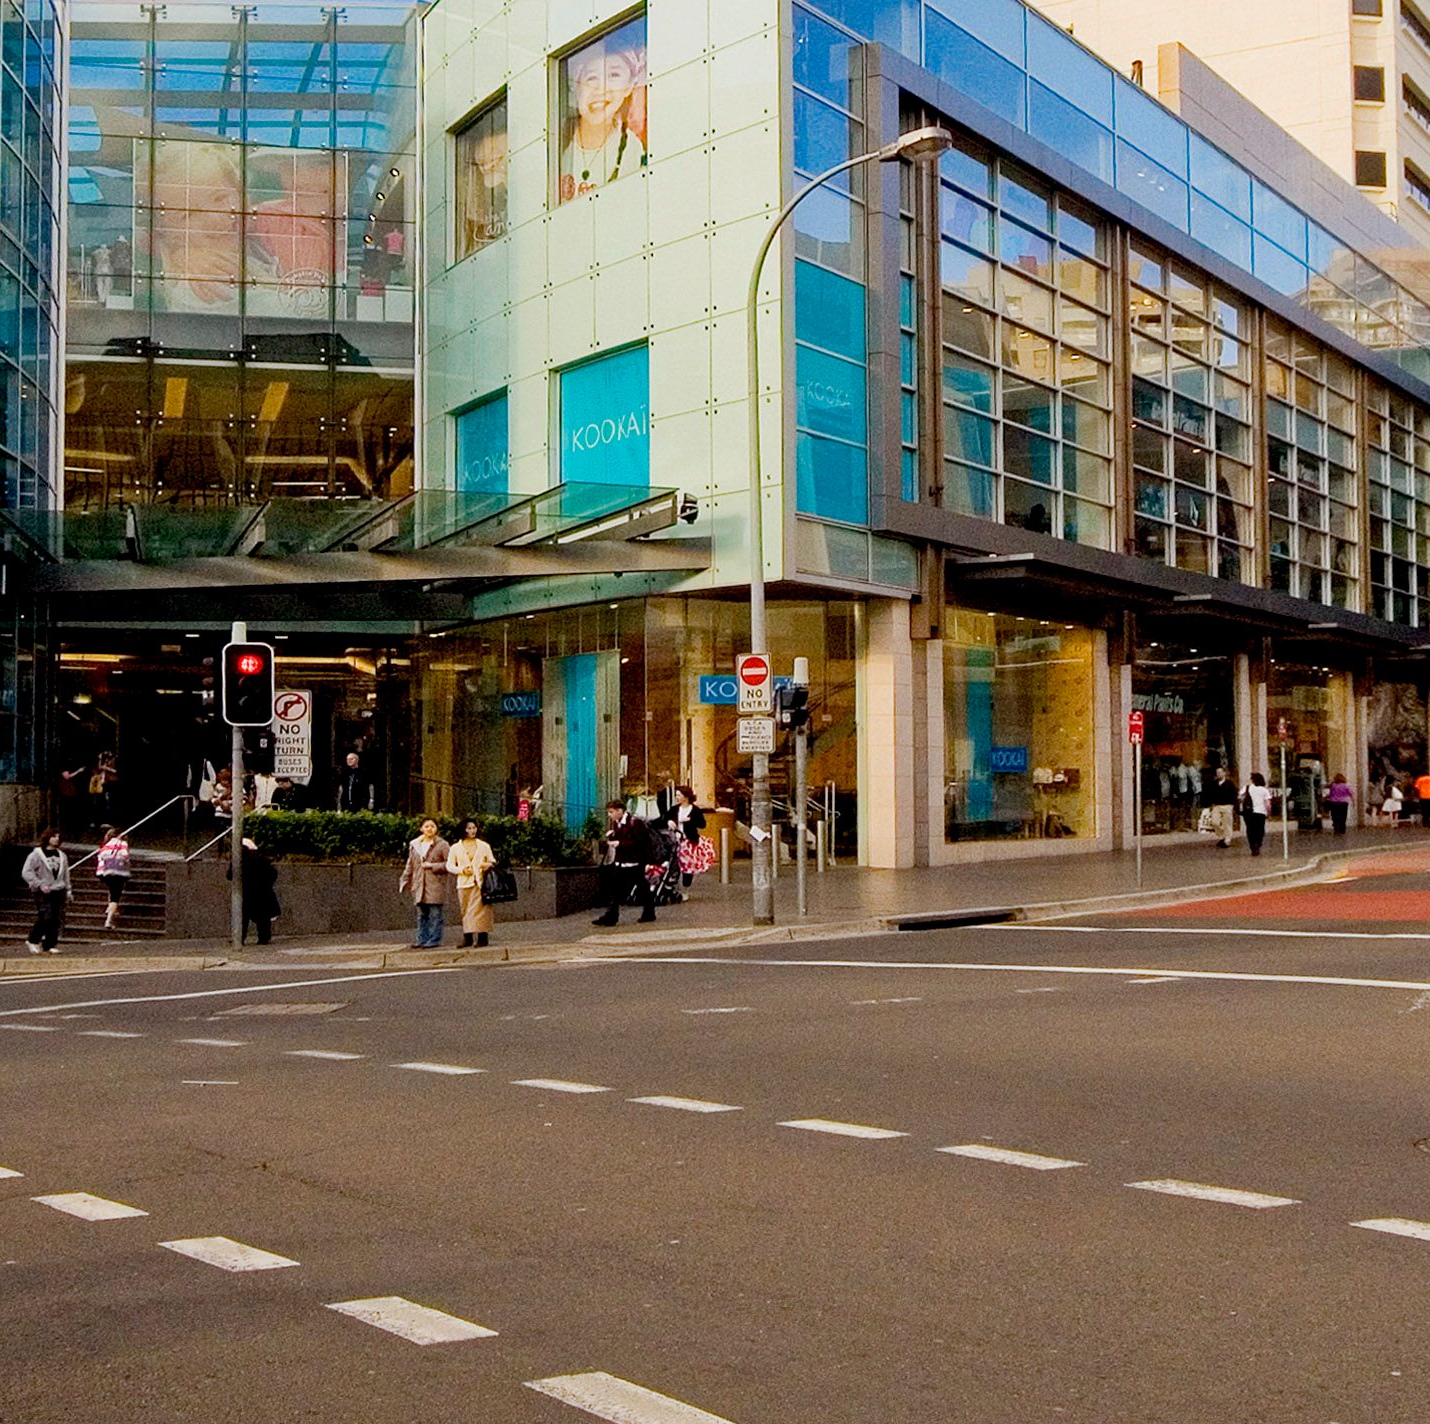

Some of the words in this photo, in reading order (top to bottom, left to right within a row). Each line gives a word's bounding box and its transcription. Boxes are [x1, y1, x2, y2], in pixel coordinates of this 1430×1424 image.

[746, 689, 763, 698] NO
[741, 700, 769, 709] ENTRY
[279, 724, 301, 734] NO
[275, 737, 305, 745] RIGHT
[275, 746, 304, 754] TURN
